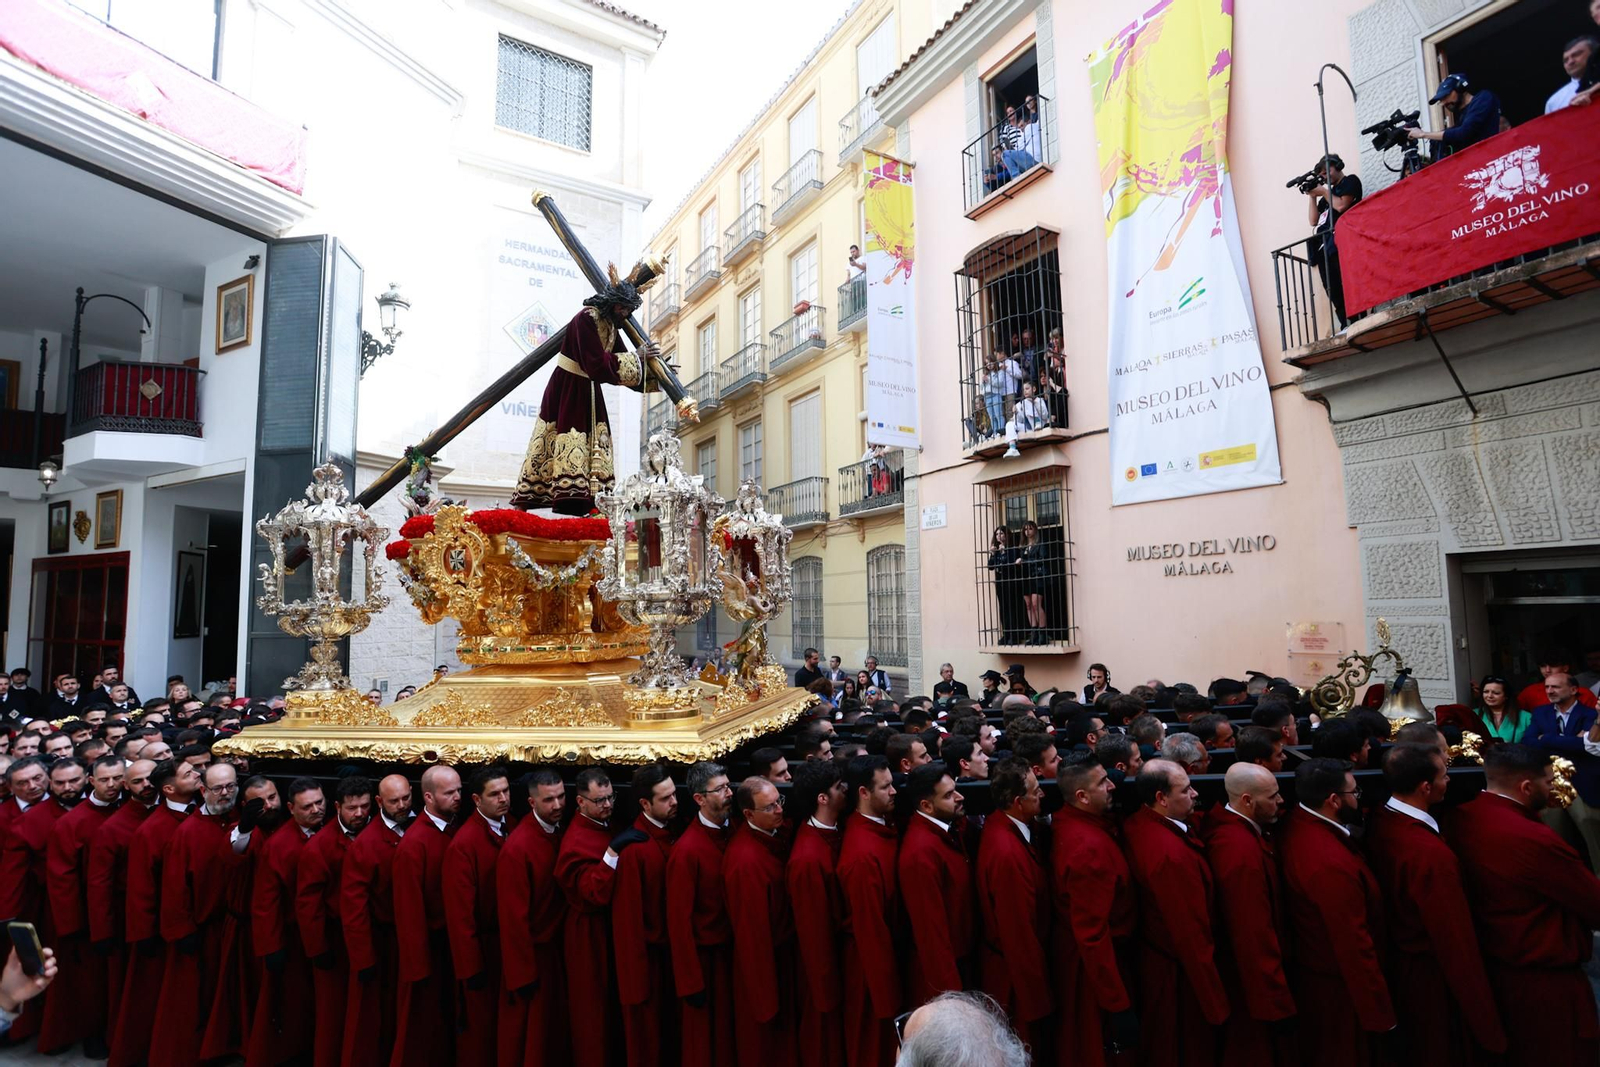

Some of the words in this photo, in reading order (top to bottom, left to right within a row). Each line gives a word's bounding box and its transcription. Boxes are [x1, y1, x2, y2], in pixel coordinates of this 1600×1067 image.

[1451, 211, 1504, 239] MUSEO
[1507, 199, 1541, 218] DEL
[1541, 183, 1589, 205] VINO
[1485, 210, 1549, 238] MÁLAGA
[498, 254, 579, 279] SACRAMENTAL
[528, 277, 544, 288] DE
[1149, 306, 1172, 319] Europa
[1162, 341, 1203, 362] SIERRAS
[868, 380, 890, 389] MUSEO
[1115, 390, 1171, 417] MUSEO
[1174, 380, 1210, 402] DEL
[1211, 365, 1262, 390] VINO
[501, 401, 541, 418] VIÑE
[1151, 399, 1218, 425] MÁLAGA
[1126, 542, 1185, 562] MUSEO
[1187, 539, 1225, 557] DEL
[1226, 534, 1277, 554] VINO
[1163, 560, 1234, 577] MÁLAGA
